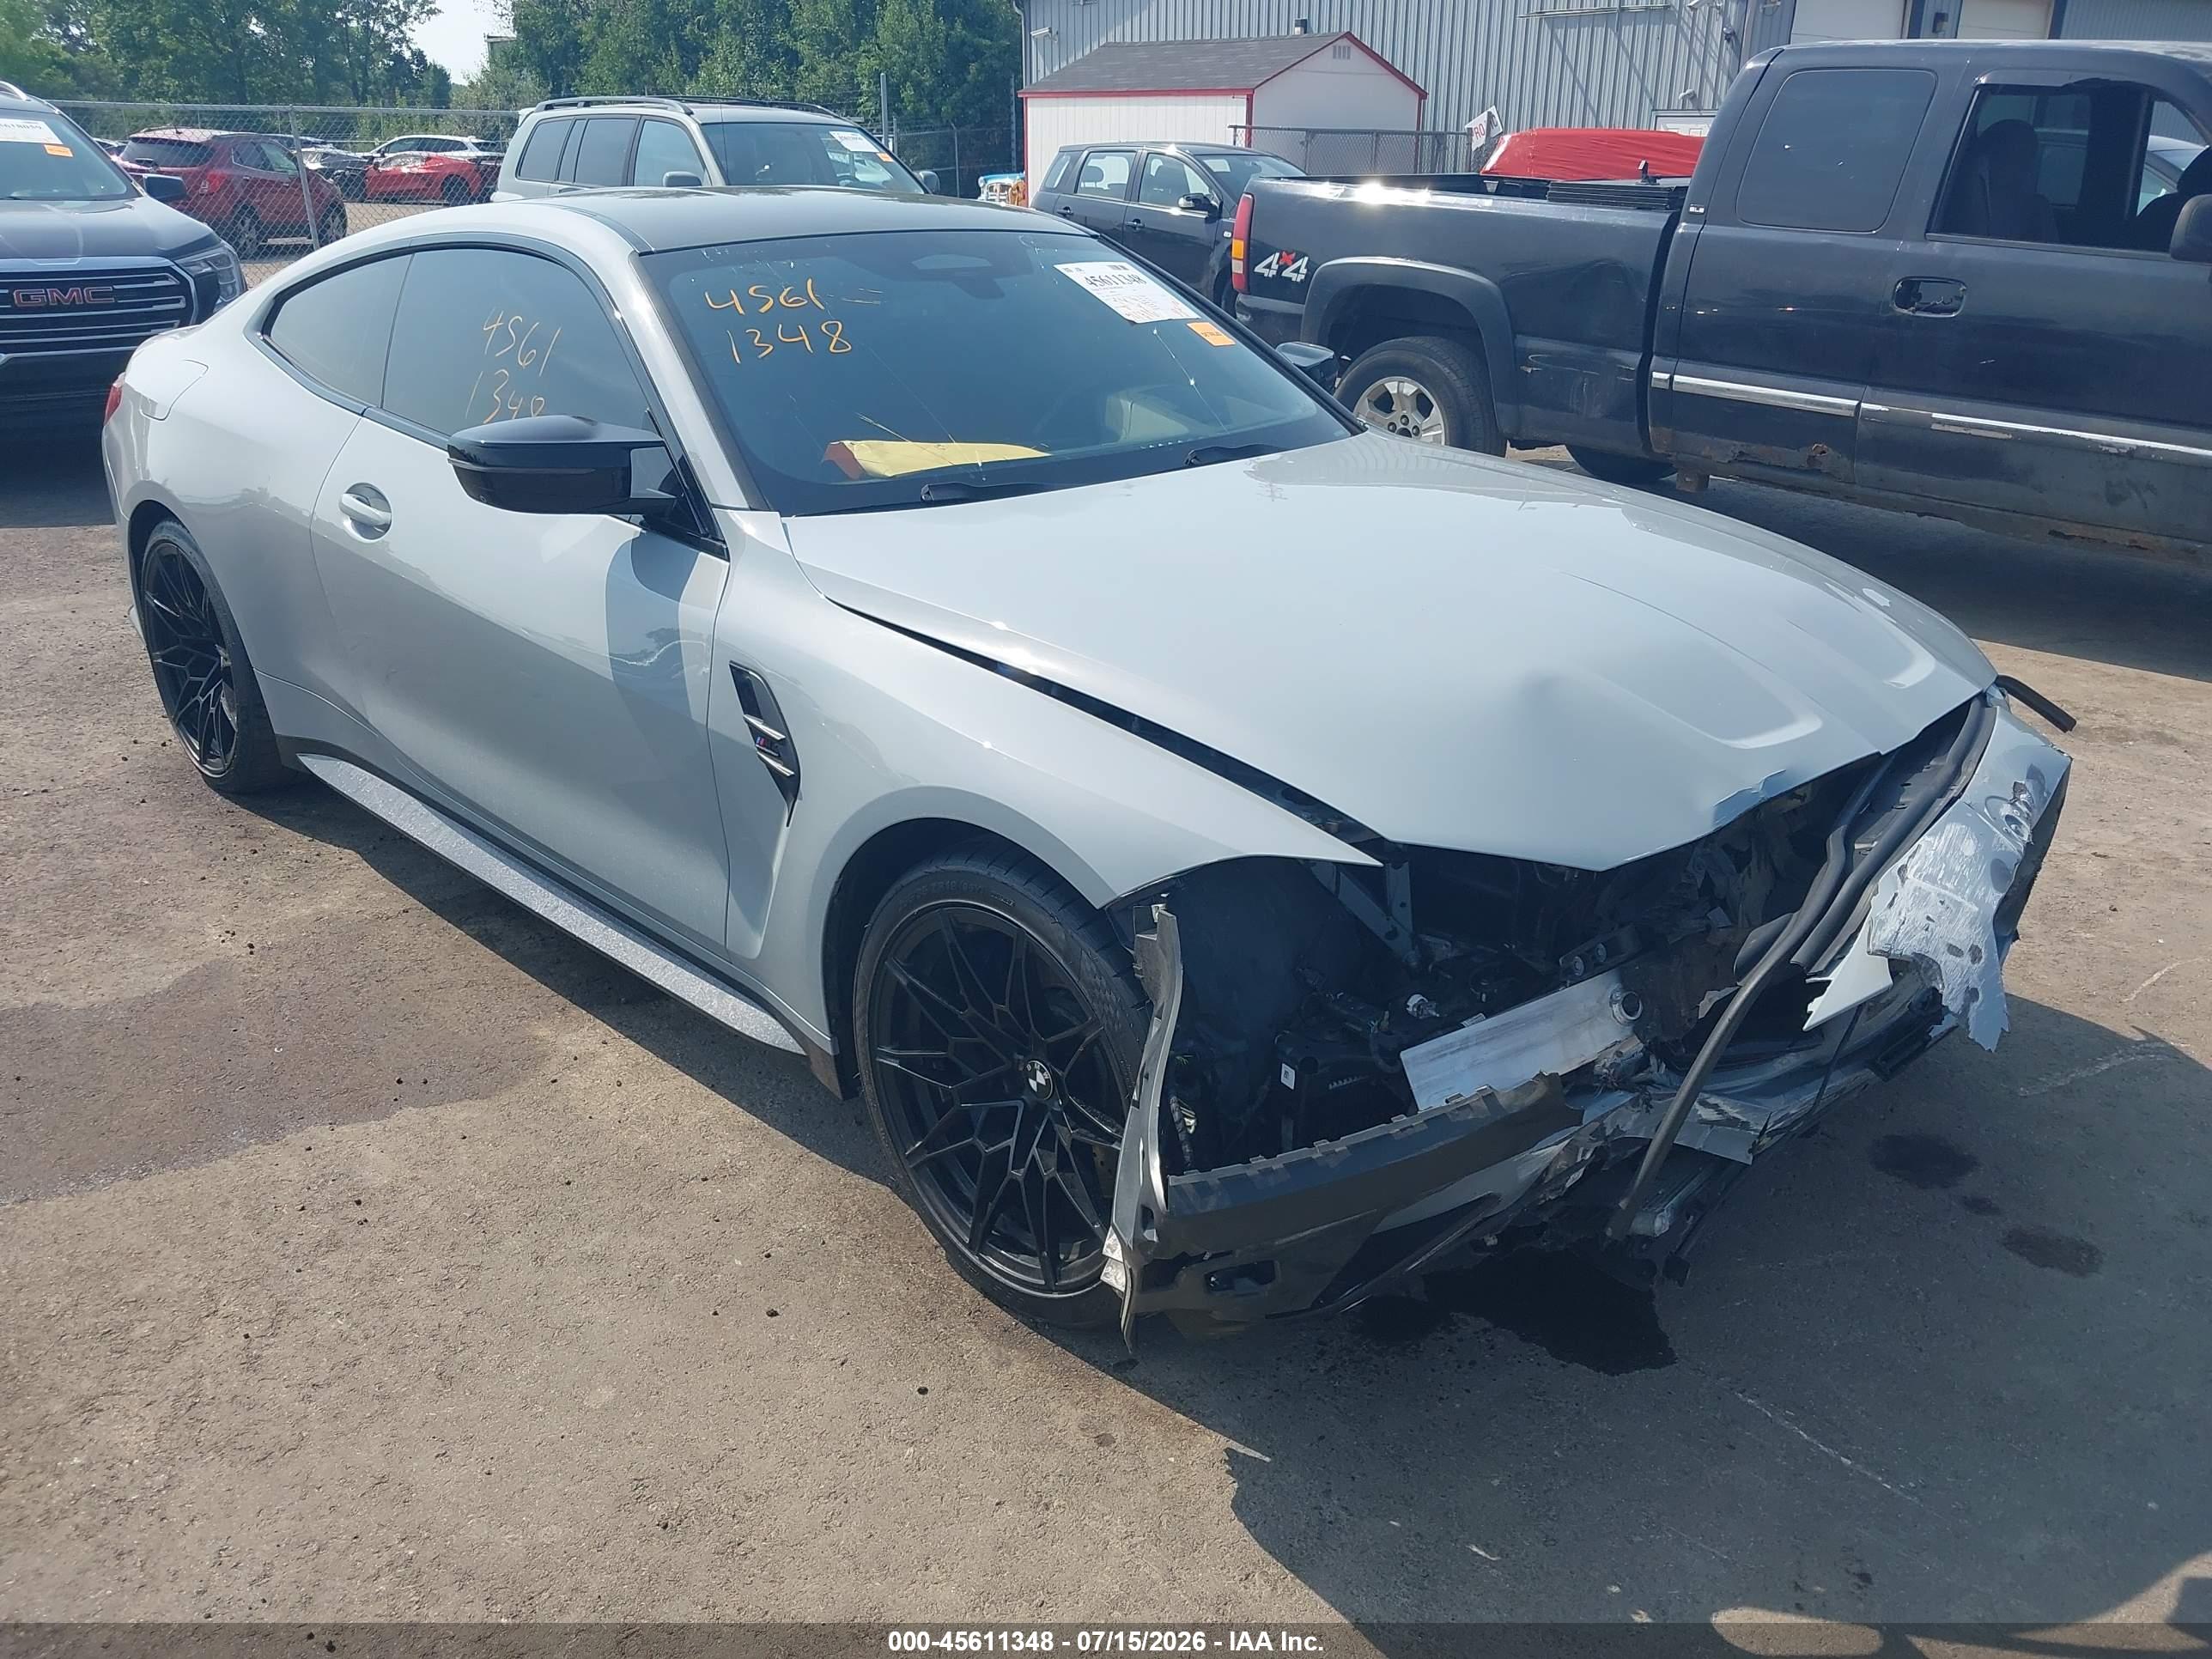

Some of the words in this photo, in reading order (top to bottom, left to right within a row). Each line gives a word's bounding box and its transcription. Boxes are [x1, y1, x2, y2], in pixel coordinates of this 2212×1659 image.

[13, 286, 115, 307] GMC
[704, 277, 825, 316] 4561
[1084, 274, 1147, 288] 45611348
[483, 307, 562, 377] 4561
[726, 320, 852, 364] 1348
